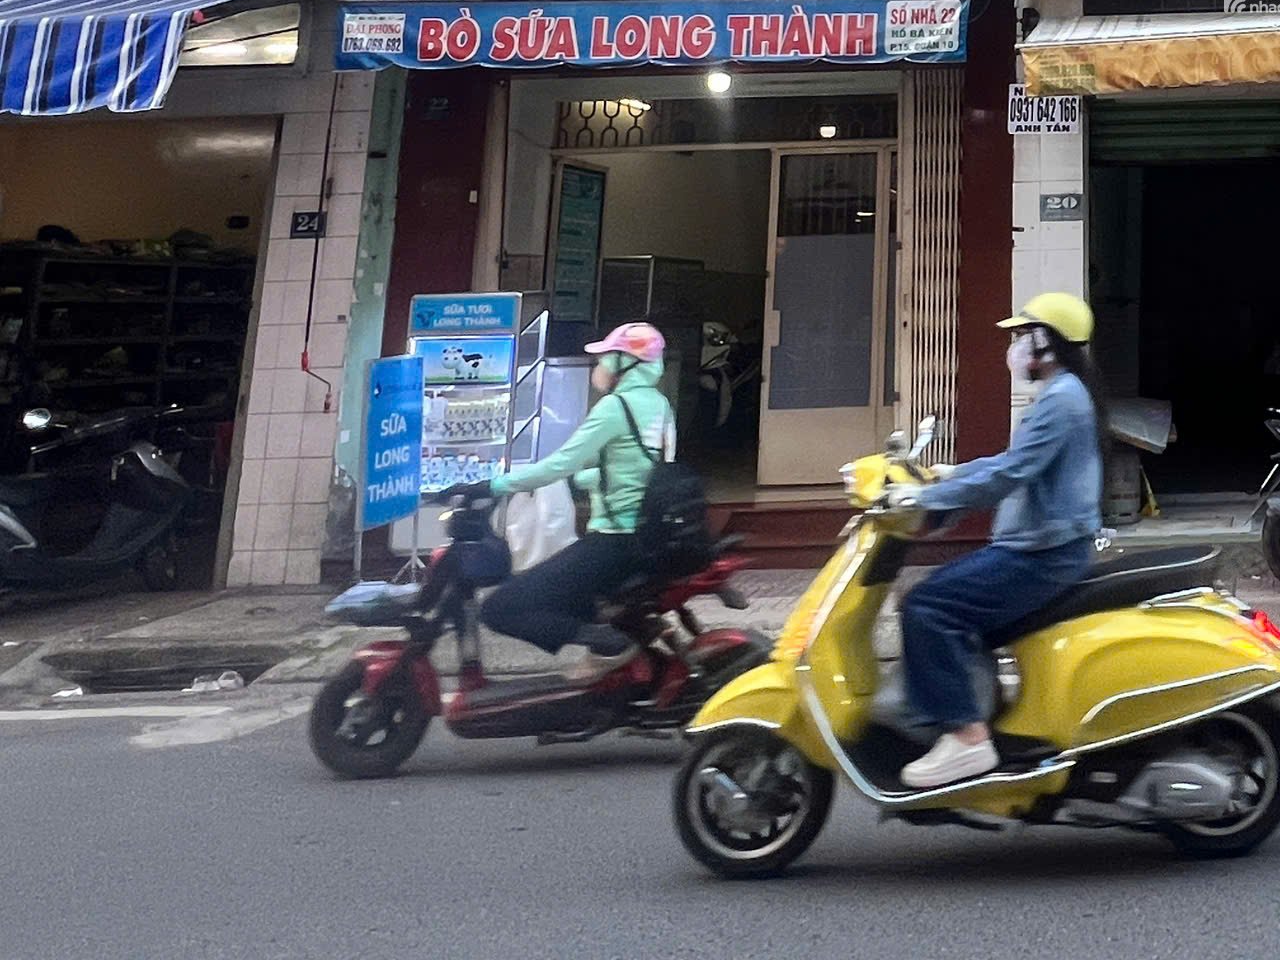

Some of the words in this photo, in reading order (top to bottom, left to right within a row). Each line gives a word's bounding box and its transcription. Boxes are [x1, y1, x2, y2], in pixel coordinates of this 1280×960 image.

[417, 8, 481, 62] BÒ
[488, 8, 579, 62] SỮA
[590, 14, 717, 60] LONG
[727, 5, 878, 59] THÀNH
[1010, 97, 1034, 122] 0931
[1037, 97, 1056, 122] 642
[1059, 97, 1077, 122] 166
[1015, 124, 1041, 132] ANH
[1047, 196, 1078, 209] 20
[296, 215, 319, 231] 24
[380, 412, 407, 437] SỮA
[374, 446, 410, 470] LONG
[367, 474, 415, 503] THÀNH
